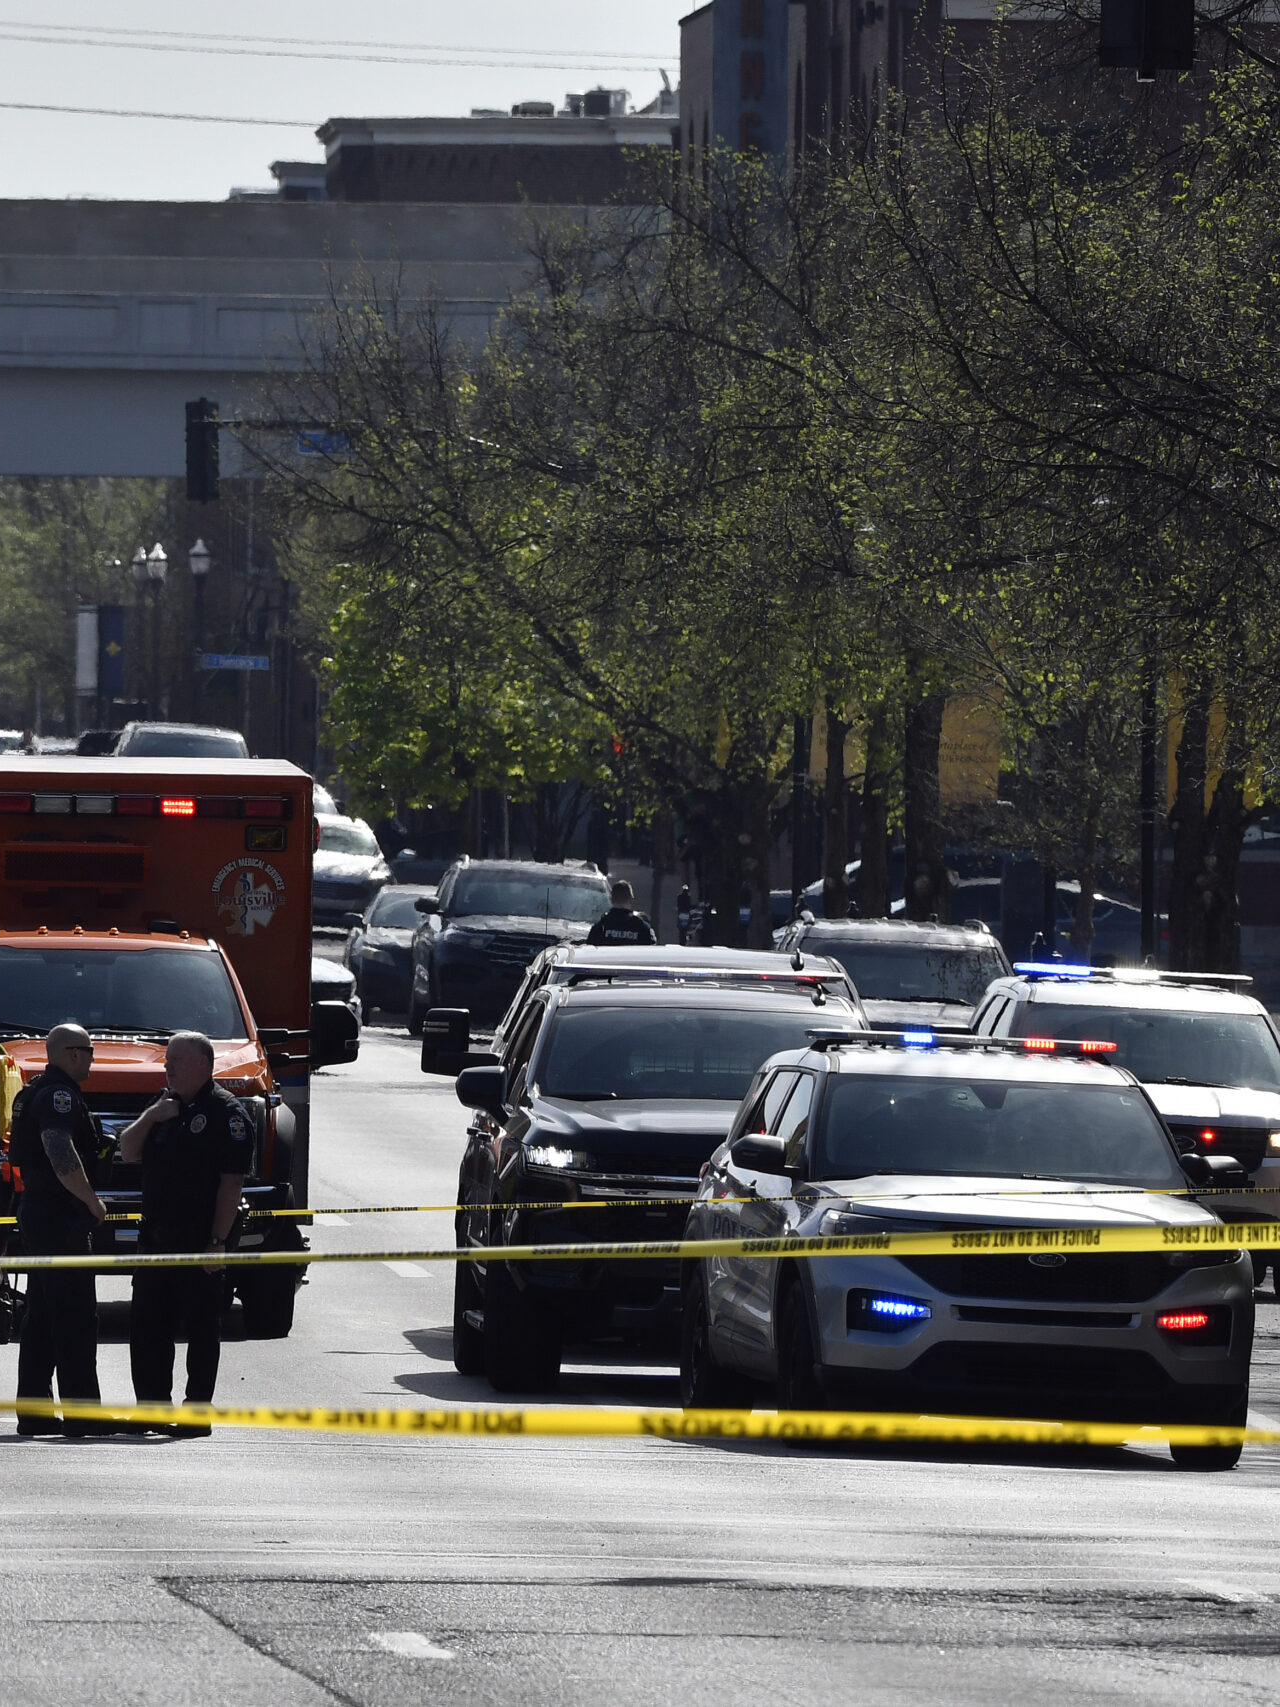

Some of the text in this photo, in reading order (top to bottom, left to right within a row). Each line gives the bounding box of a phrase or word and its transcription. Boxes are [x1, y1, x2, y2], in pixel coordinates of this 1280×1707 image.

[214, 891, 286, 906] Louisville
[604, 929, 639, 940] POLICE
[952, 1230, 1101, 1248] POLICE LINE DO NOT CROSS
[1162, 1227, 1200, 1244] CROSS
[1203, 1226, 1225, 1243] NOT
[1228, 1226, 1243, 1243] DO
[1247, 1225, 1270, 1243] LINE
[742, 1236, 891, 1252] POLICE LINE DO NOT CROSS
